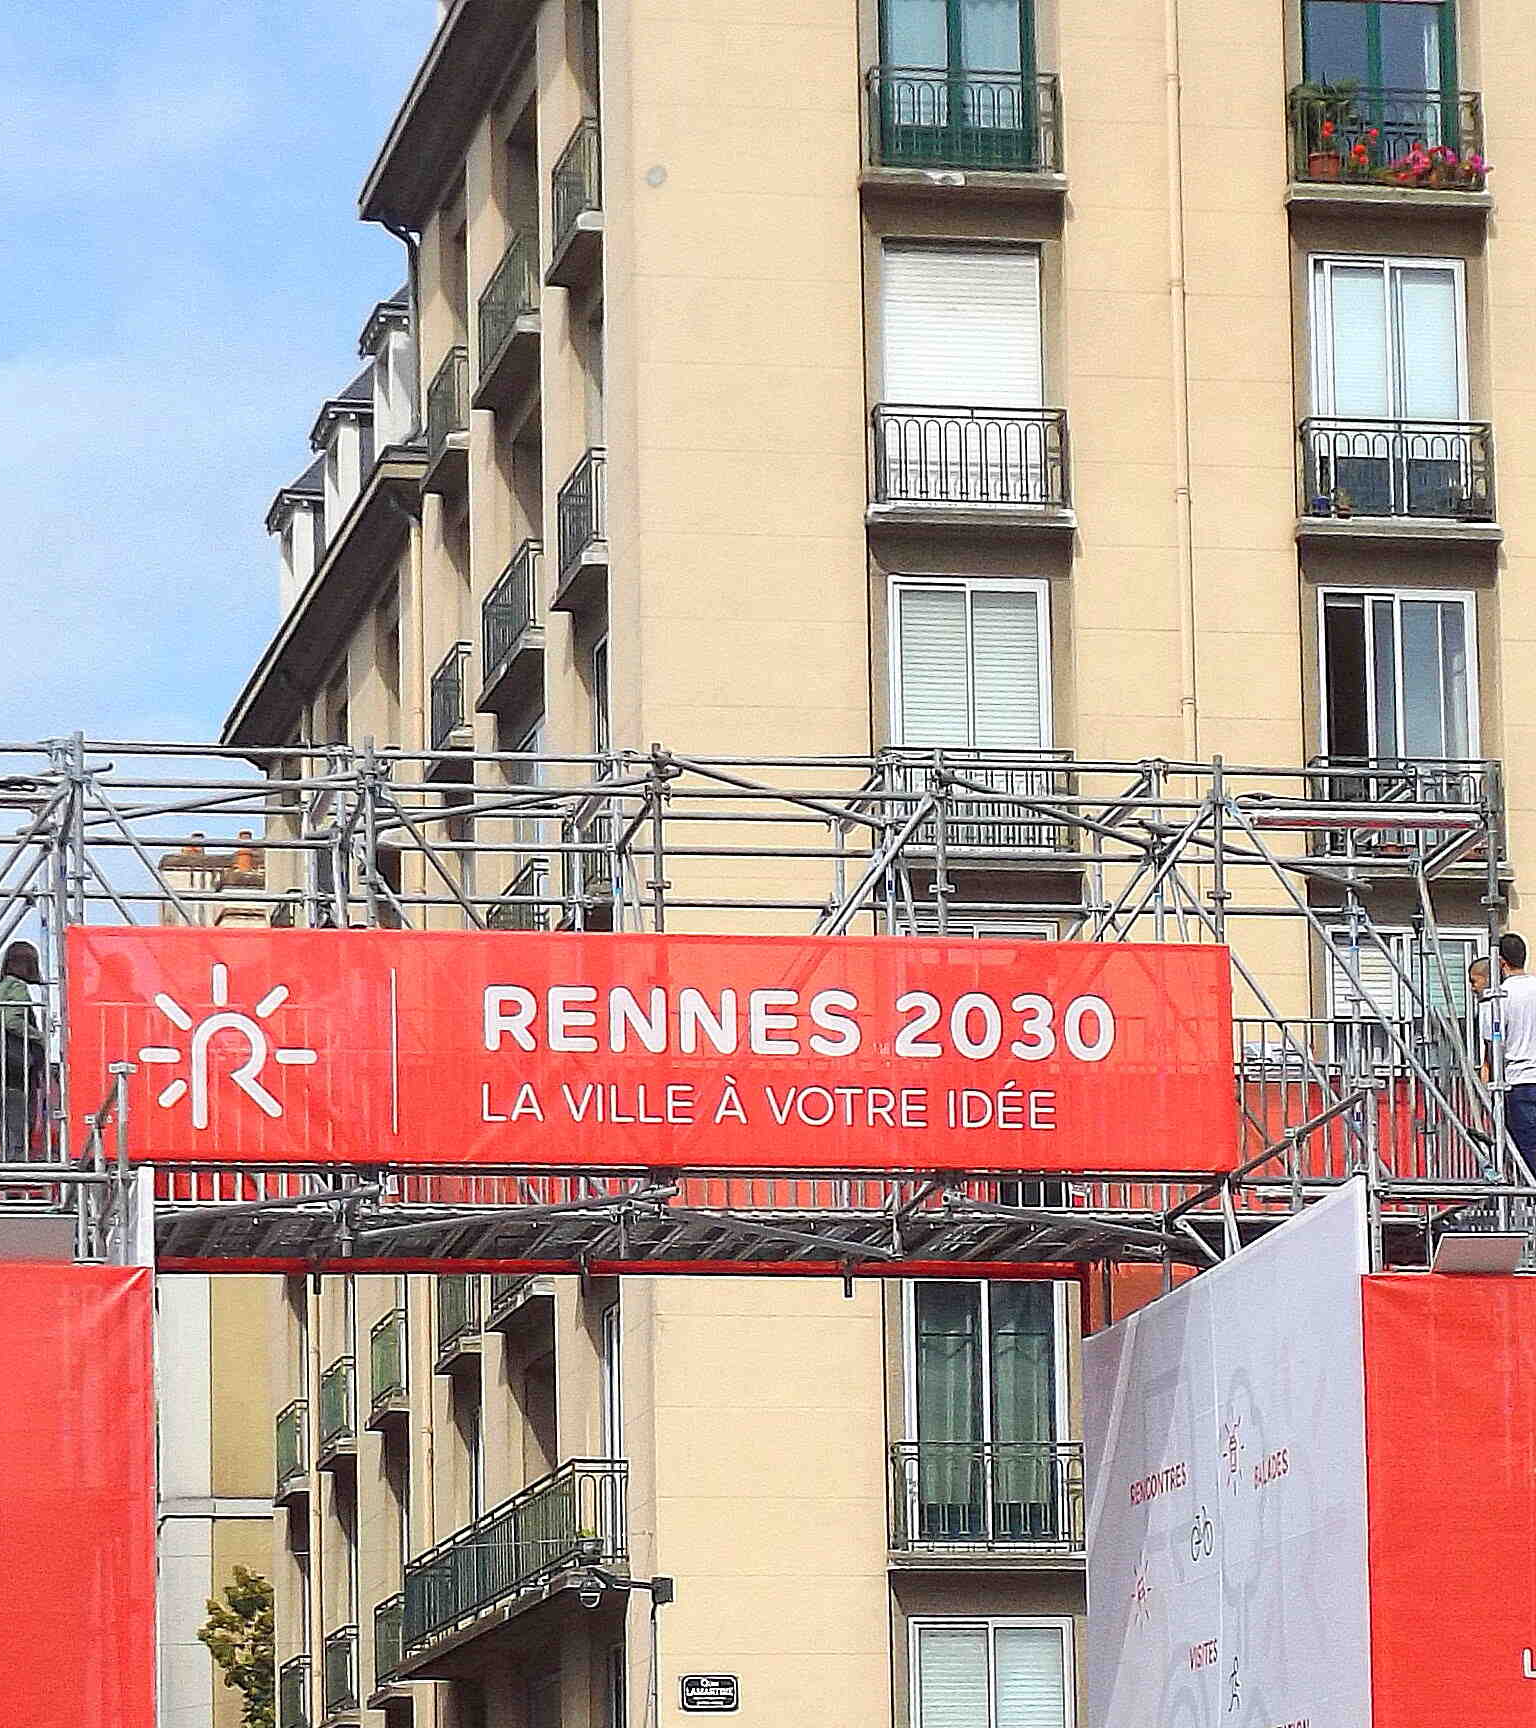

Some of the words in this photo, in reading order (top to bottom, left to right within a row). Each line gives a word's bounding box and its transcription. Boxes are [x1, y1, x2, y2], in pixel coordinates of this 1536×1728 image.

[482, 985, 857, 1058] RENNES
[895, 990, 1117, 1063] 2030
[481, 1081, 545, 1123] LA
[562, 1082, 695, 1125] VILLE
[712, 1074, 749, 1126] À
[764, 1085, 928, 1129] VOTRE
[947, 1078, 1057, 1131] IDÉE
[1128, 1461, 1188, 1506] RENCONTRES
[1252, 1446, 1289, 1491] BALADES
[1188, 1638, 1219, 1672] VISITES
